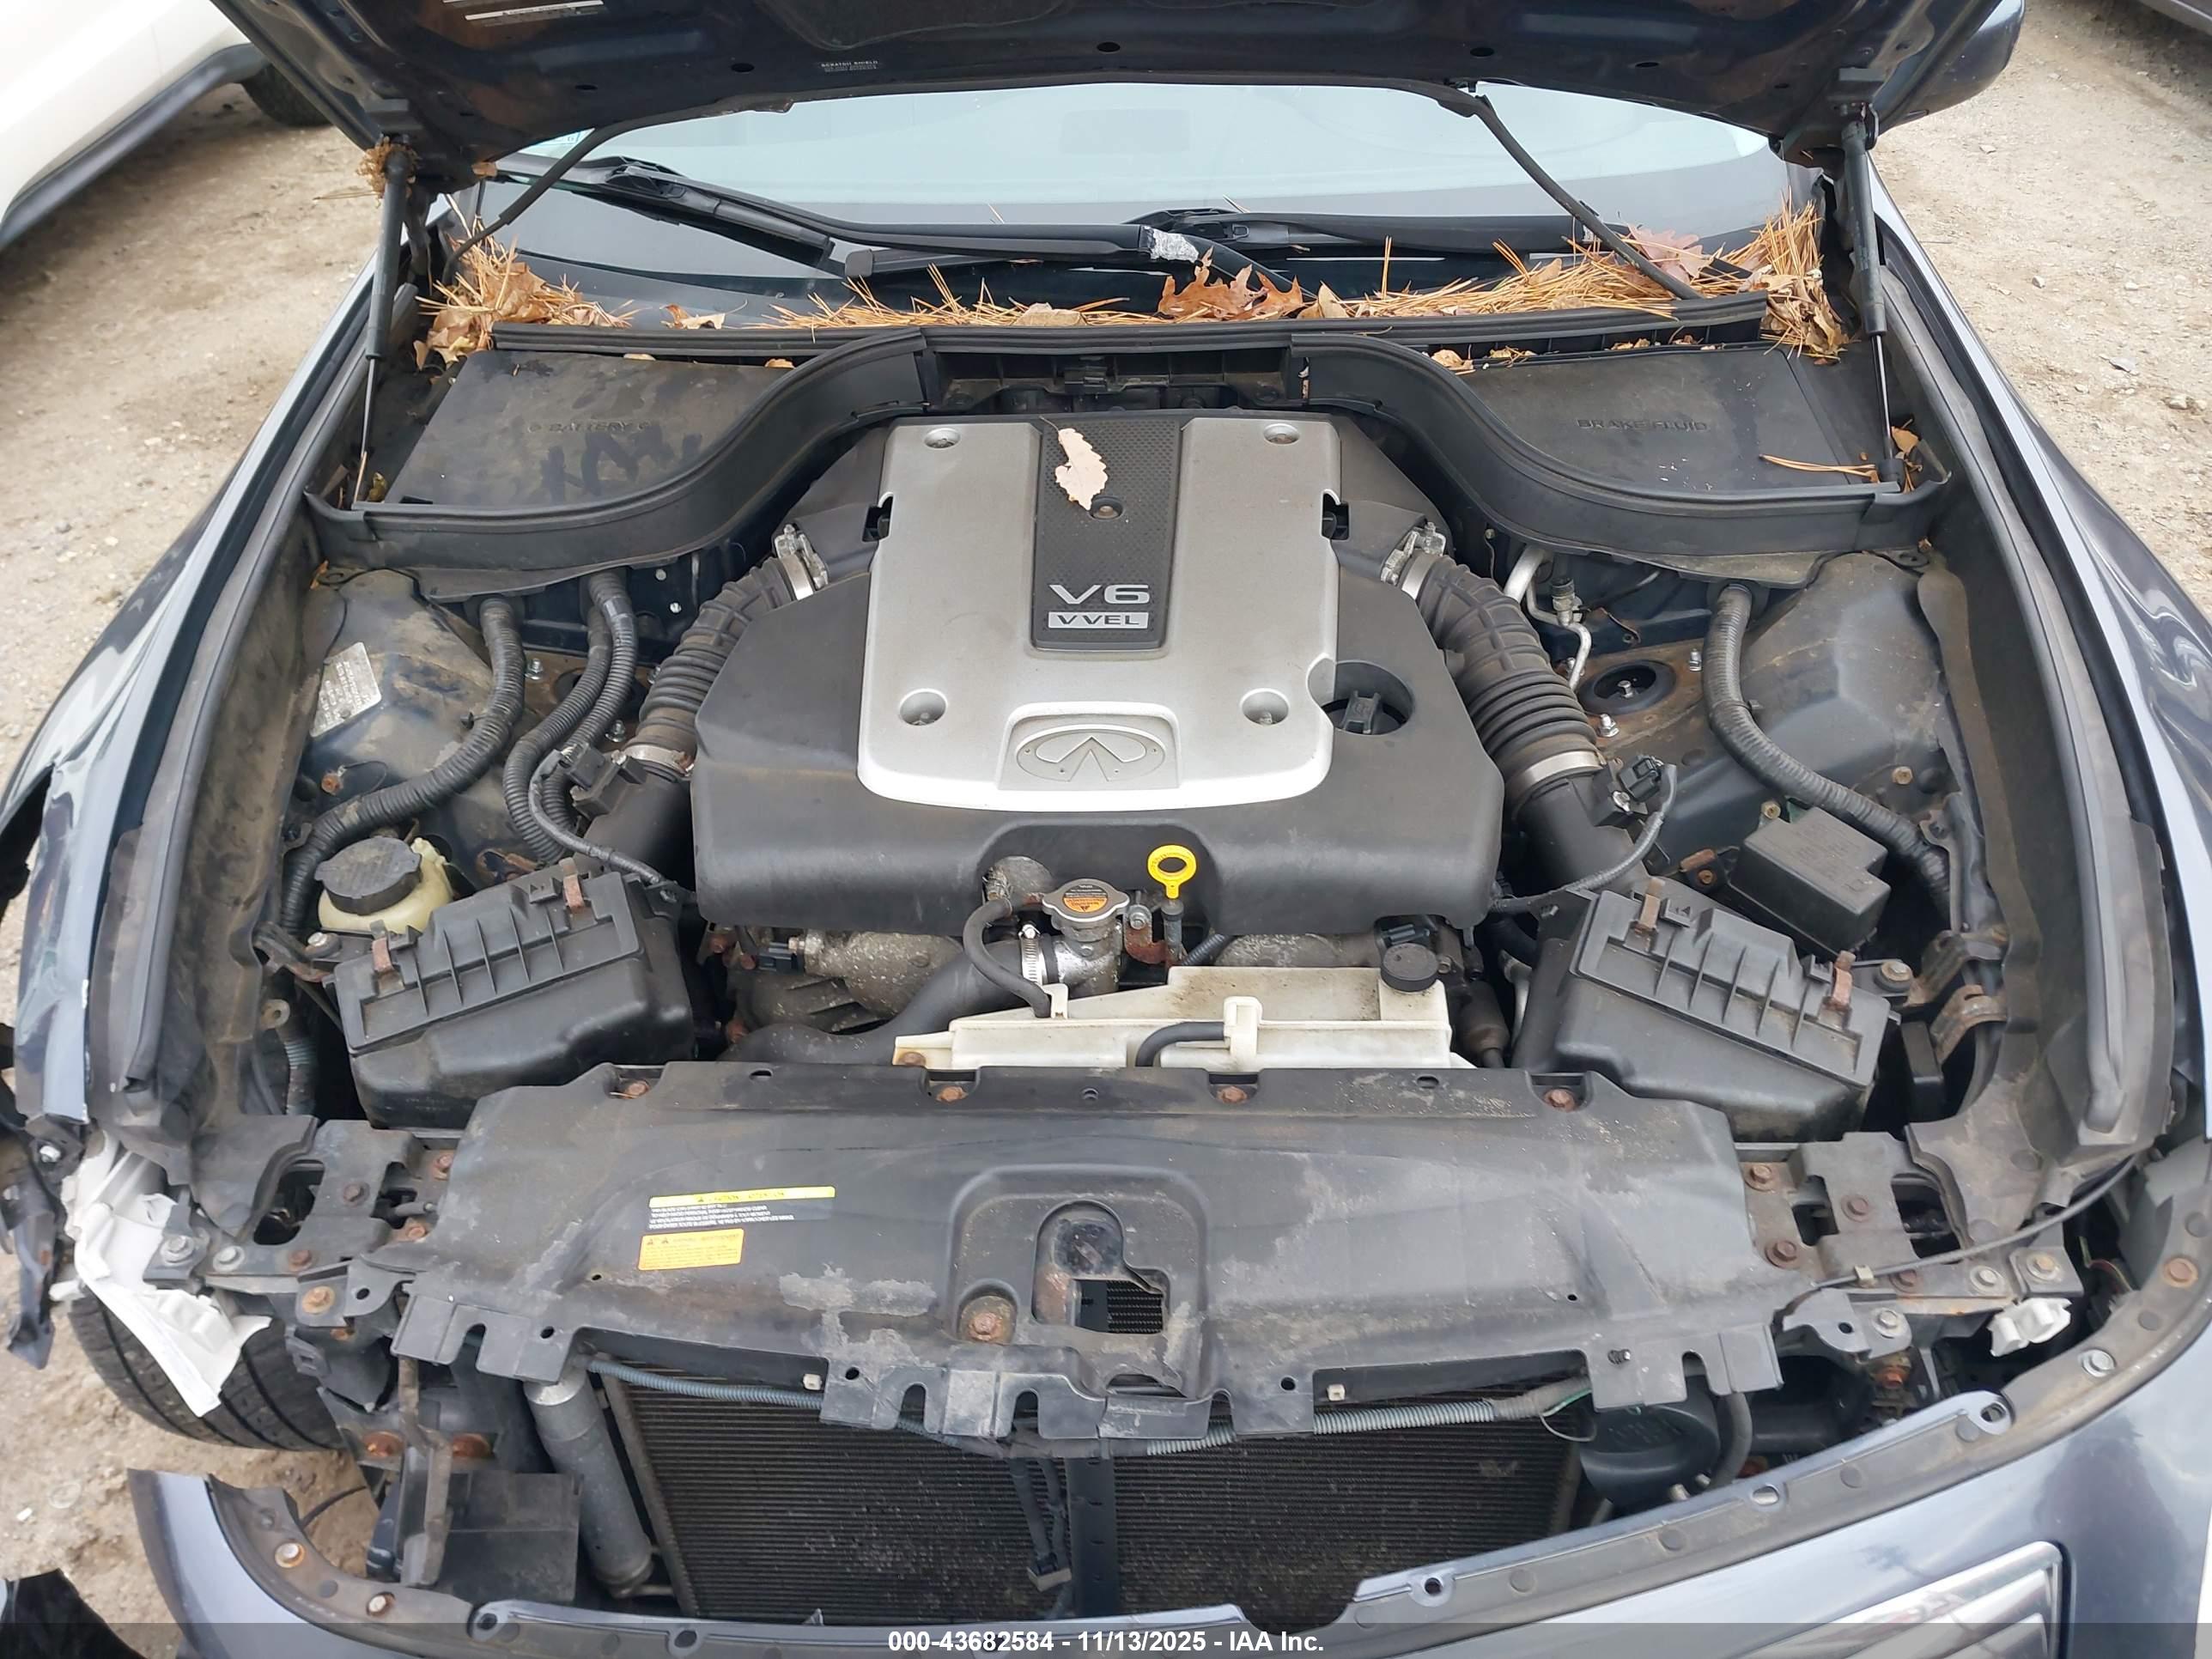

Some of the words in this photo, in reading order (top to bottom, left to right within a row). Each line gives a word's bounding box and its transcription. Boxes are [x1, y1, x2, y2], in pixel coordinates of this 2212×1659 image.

[1577, 419, 1648, 431] BRAKE
[1652, 419, 1709, 431] FLUID
[1049, 585, 1150, 605] V6
[1057, 615, 1140, 625] VVEL
